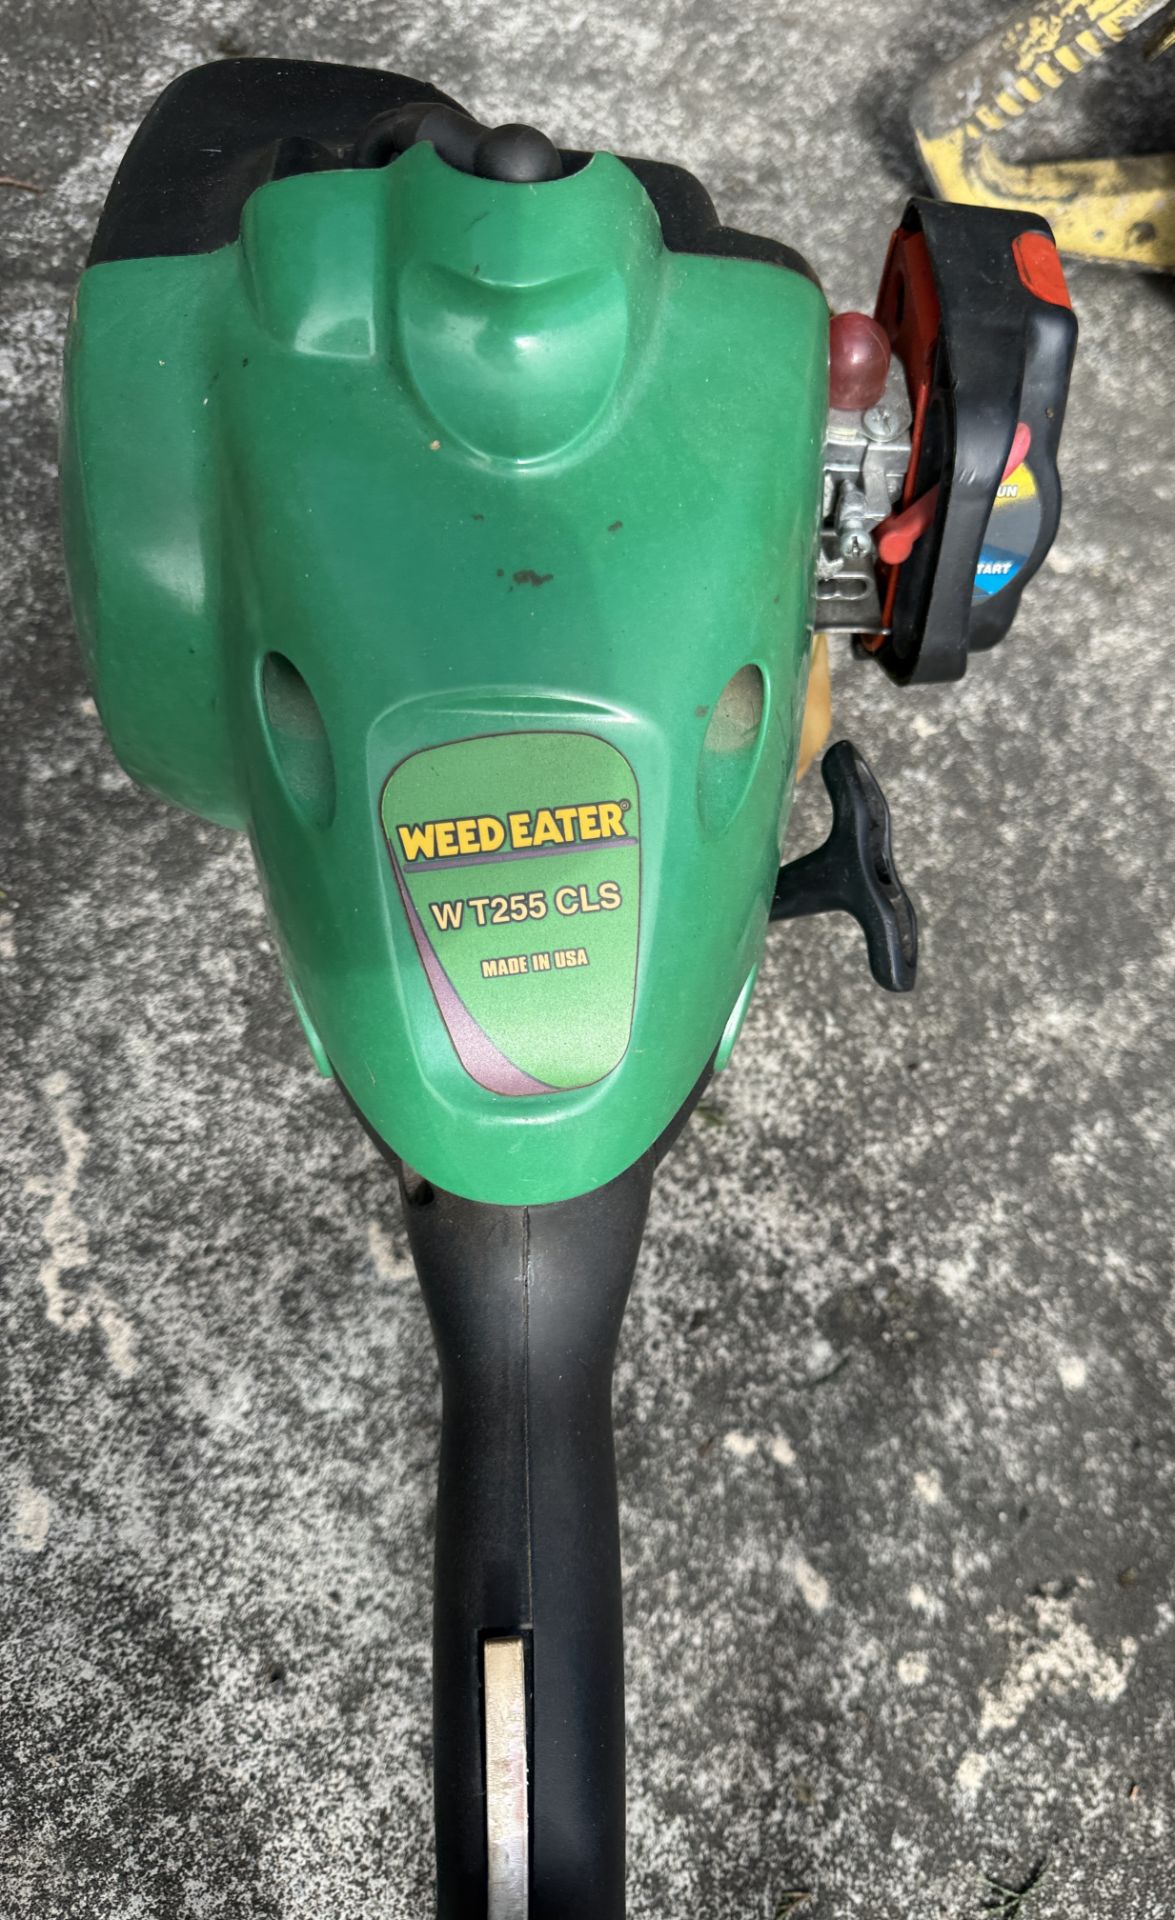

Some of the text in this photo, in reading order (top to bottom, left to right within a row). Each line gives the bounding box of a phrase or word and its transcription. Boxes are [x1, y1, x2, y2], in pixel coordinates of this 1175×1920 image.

[996, 486, 1017, 497] UN
[976, 561, 1012, 574] TART
[397, 815, 506, 861] WEED
[555, 880, 622, 916] CLS
[480, 948, 589, 979] MADE IN USA
